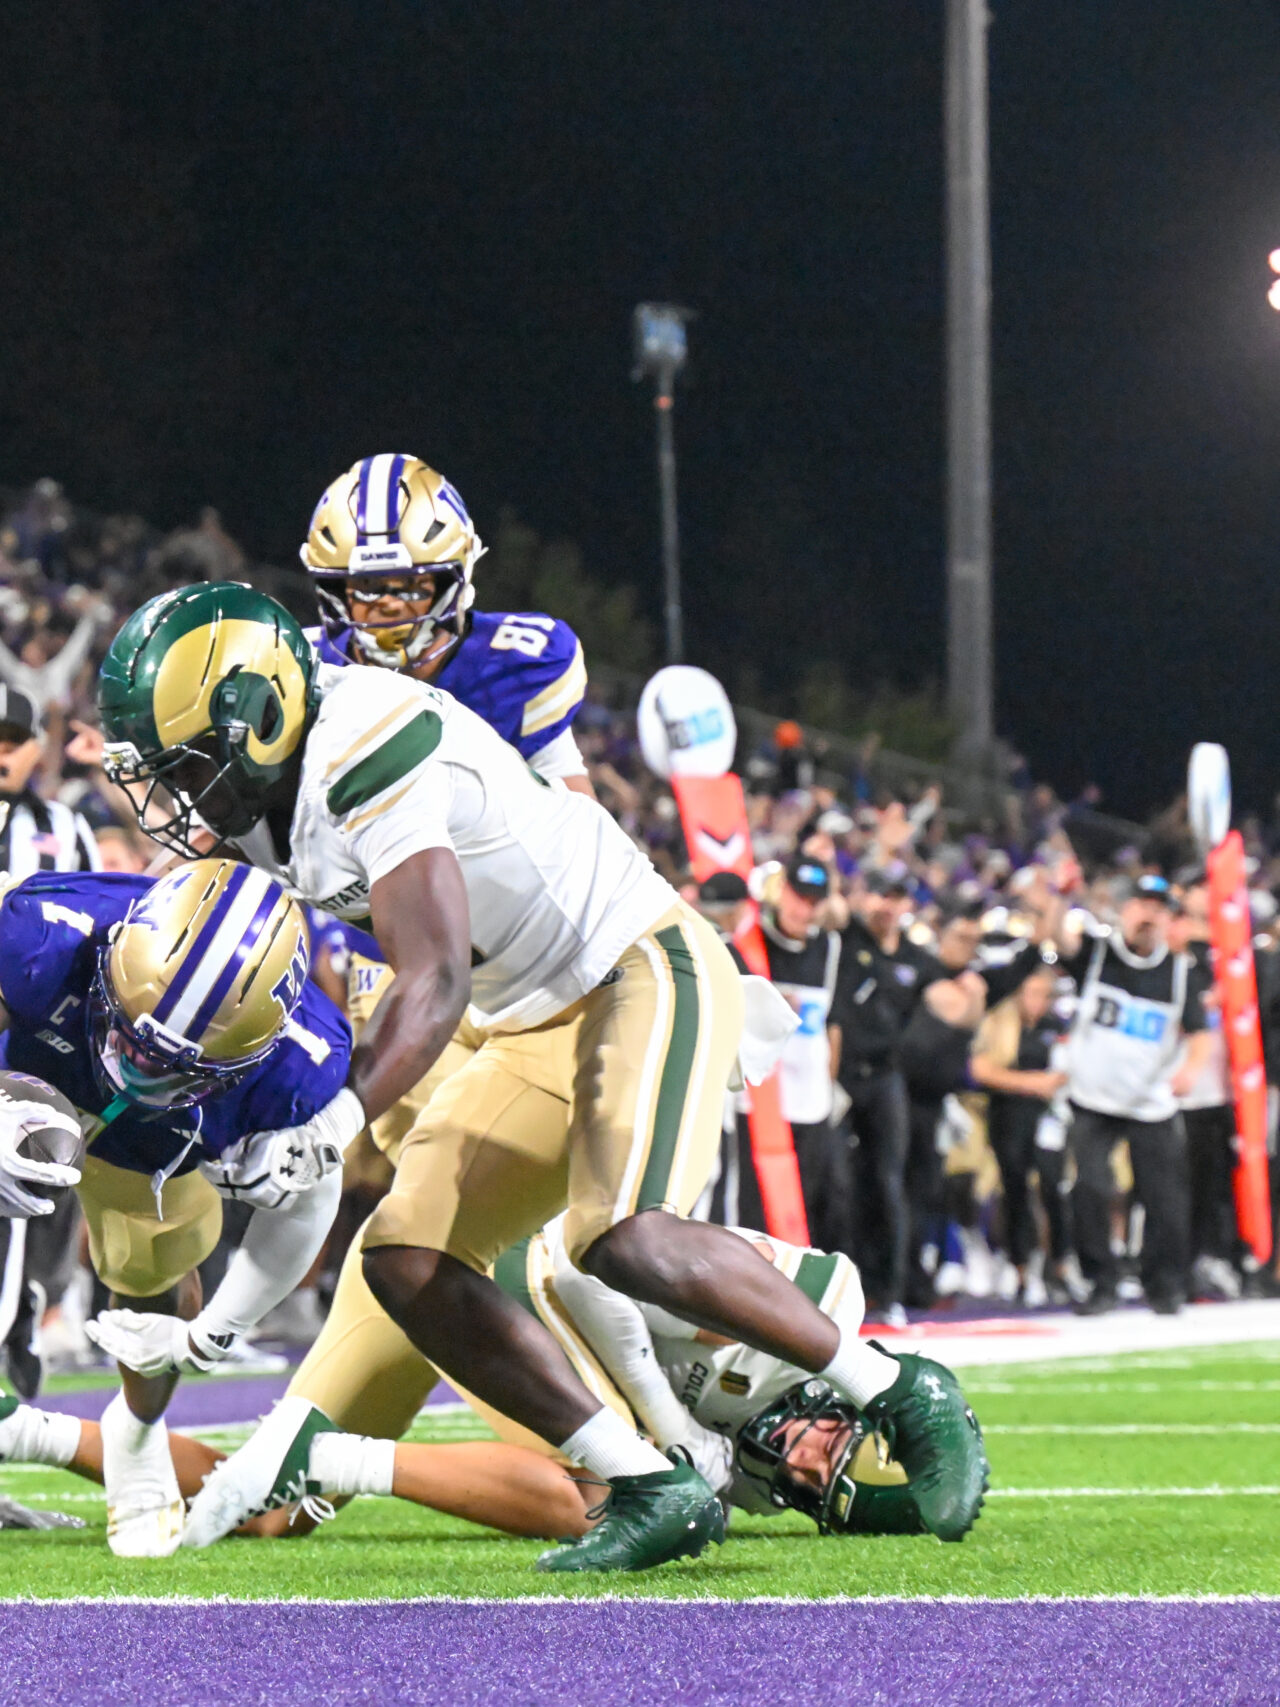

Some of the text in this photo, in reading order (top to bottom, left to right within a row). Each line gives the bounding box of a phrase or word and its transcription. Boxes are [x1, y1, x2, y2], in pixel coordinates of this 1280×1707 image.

[489, 614, 556, 658] 81
[356, 967, 384, 992] W
[49, 994, 81, 1025] C
